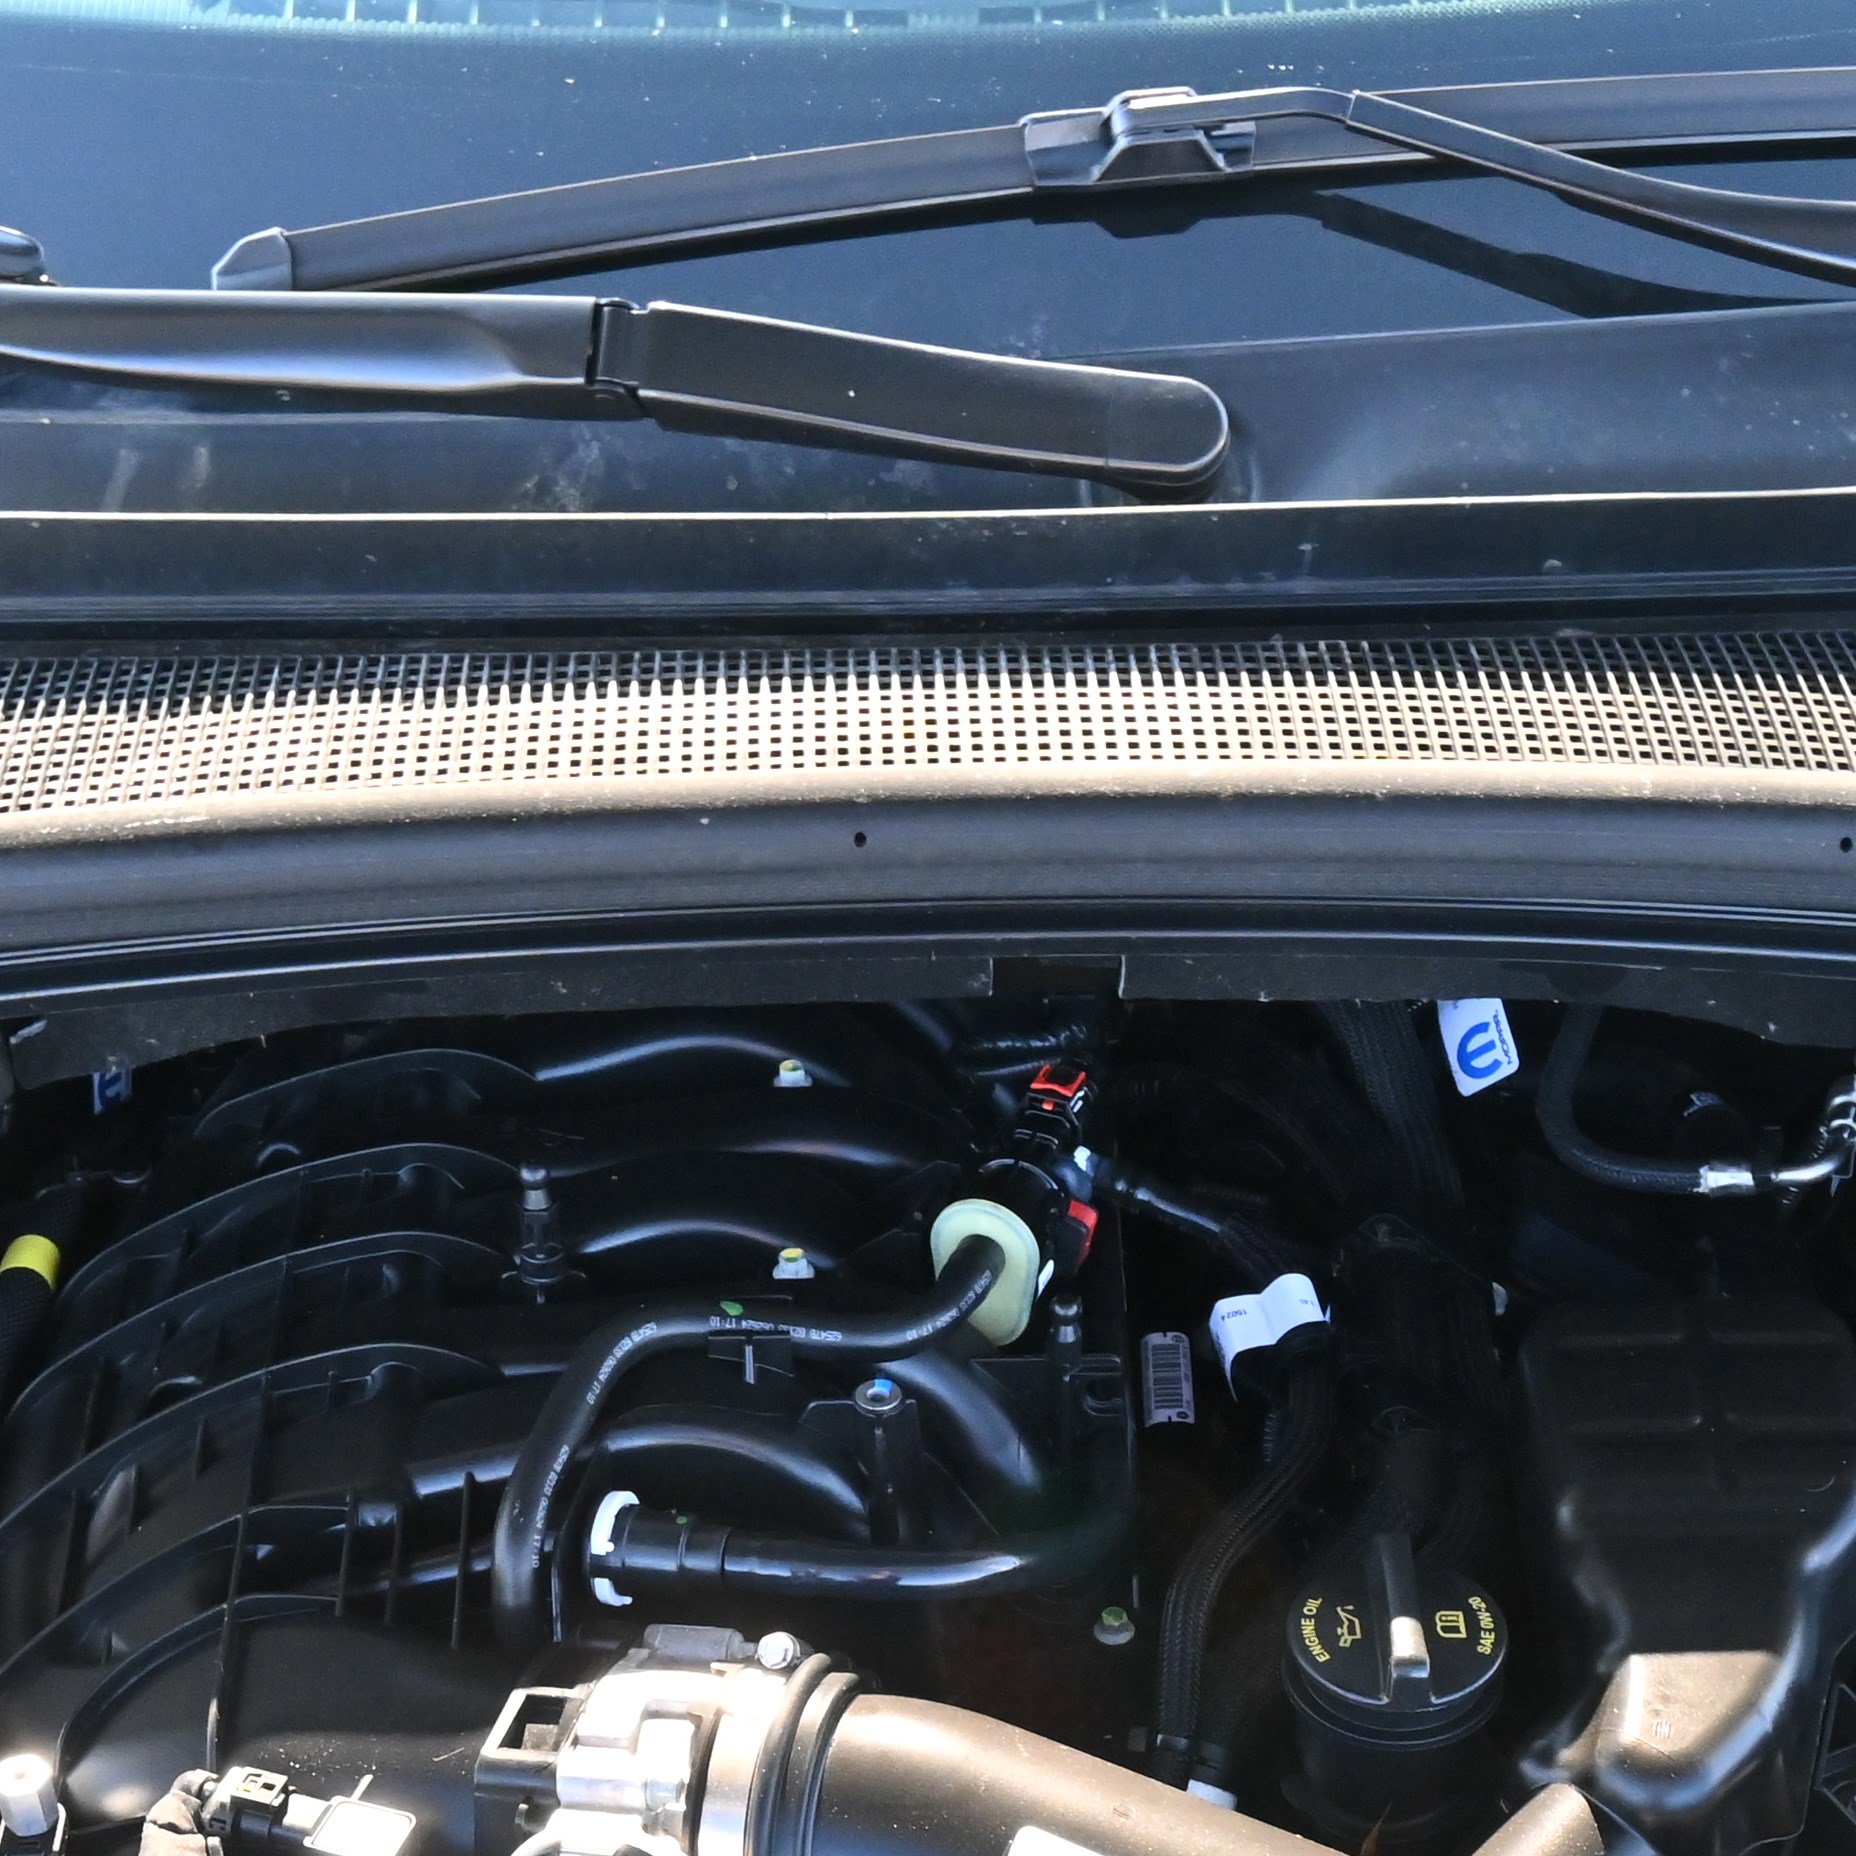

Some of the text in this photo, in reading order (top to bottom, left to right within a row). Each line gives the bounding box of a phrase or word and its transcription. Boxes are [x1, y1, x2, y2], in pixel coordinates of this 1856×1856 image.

[1301, 1597, 1331, 1663] ENGINE OIL
[1467, 1596, 1496, 1656] SAE 0W-20
